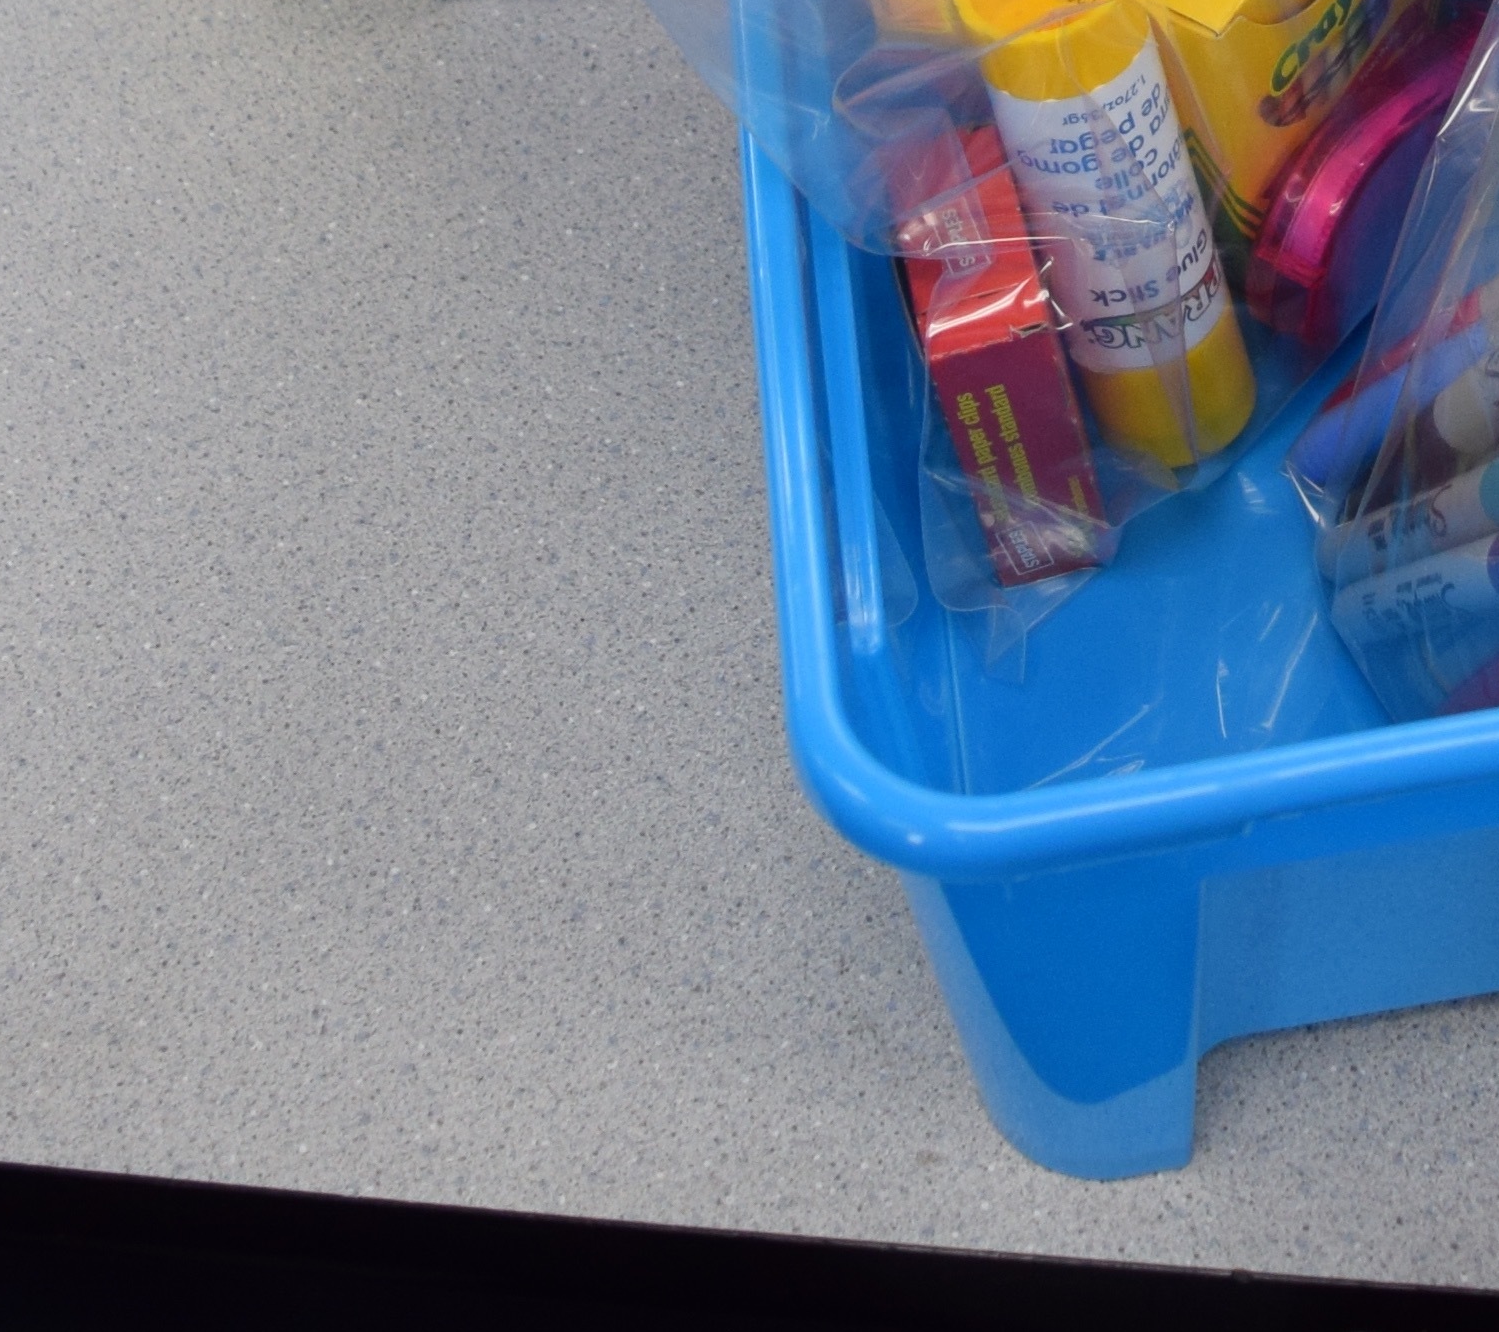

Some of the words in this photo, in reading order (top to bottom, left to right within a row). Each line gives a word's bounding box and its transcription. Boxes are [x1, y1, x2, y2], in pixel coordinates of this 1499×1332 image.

[1050, 111, 1135, 156] pegar
[1110, 132, 1145, 166] de
[1016, 148, 1099, 180] goma
[1094, 147, 1160, 194] colle
[1088, 276, 1162, 308] Stick
[953, 391, 982, 426] clips
[985, 383, 1021, 443] standard
[968, 425, 998, 464] paper
